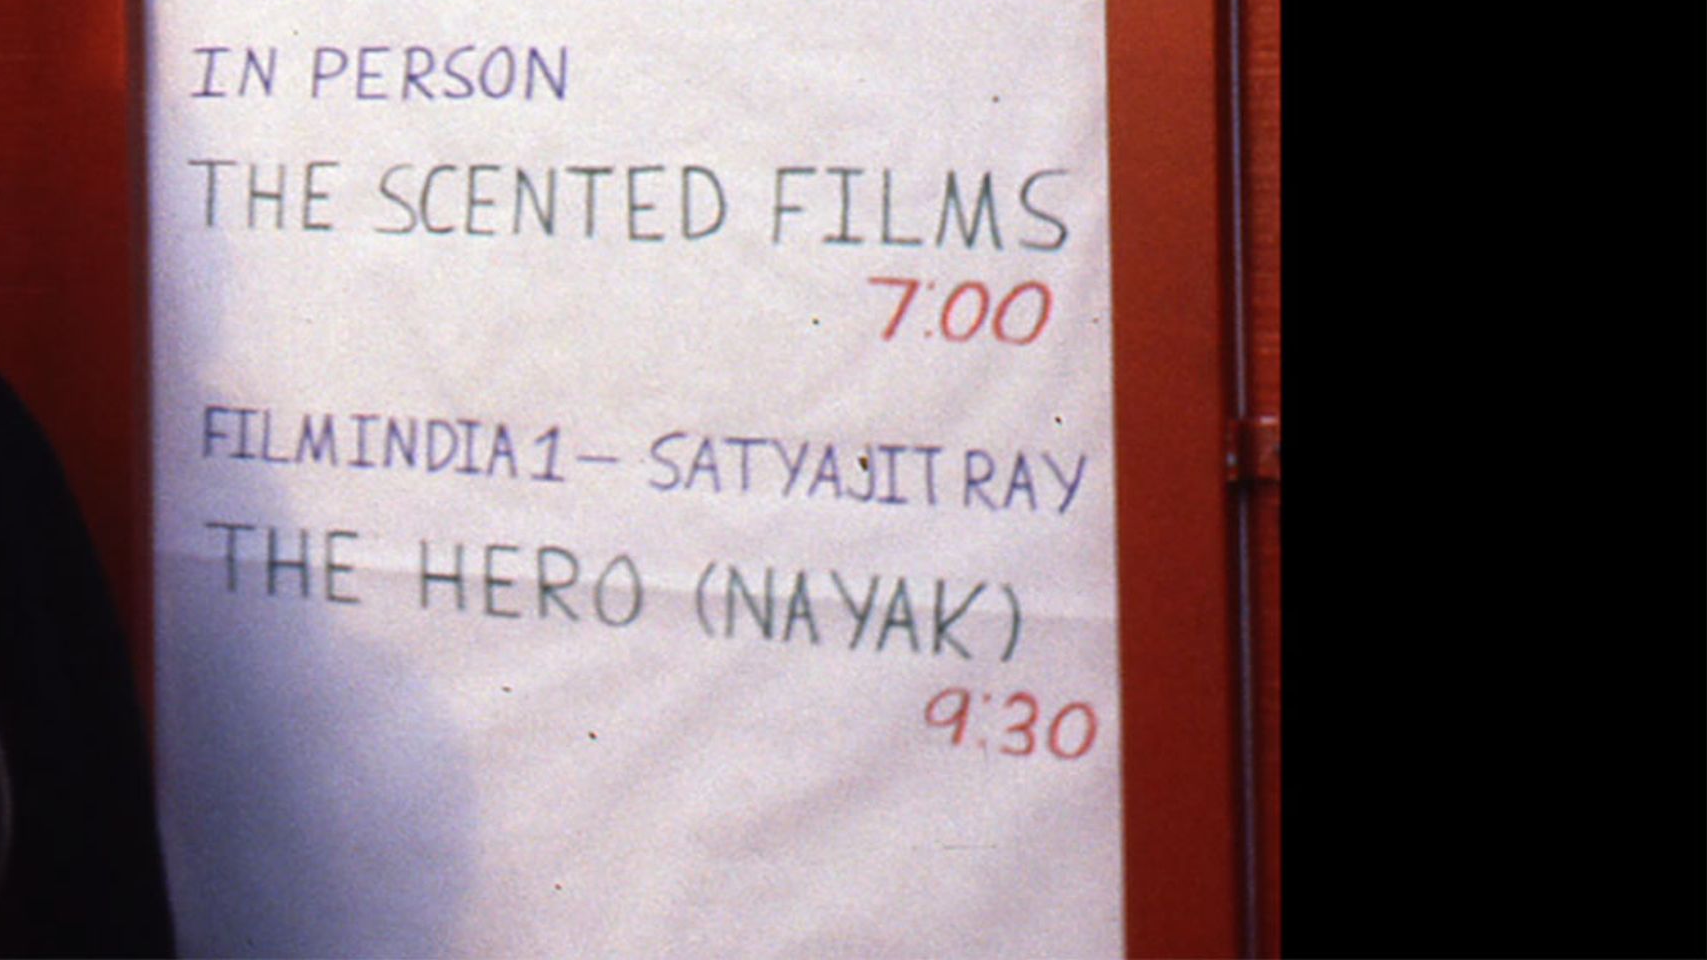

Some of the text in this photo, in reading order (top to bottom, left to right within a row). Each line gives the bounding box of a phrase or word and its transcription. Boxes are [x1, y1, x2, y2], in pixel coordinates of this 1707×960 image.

[192, 44, 568, 101] IN PERSON
[188, 160, 1070, 252] THE SCENTED FILMS
[868, 277, 1053, 346] 7:00
[204, 522, 1023, 662] THE HERO (NAYAK)
[924, 688, 1096, 760] 9:30
